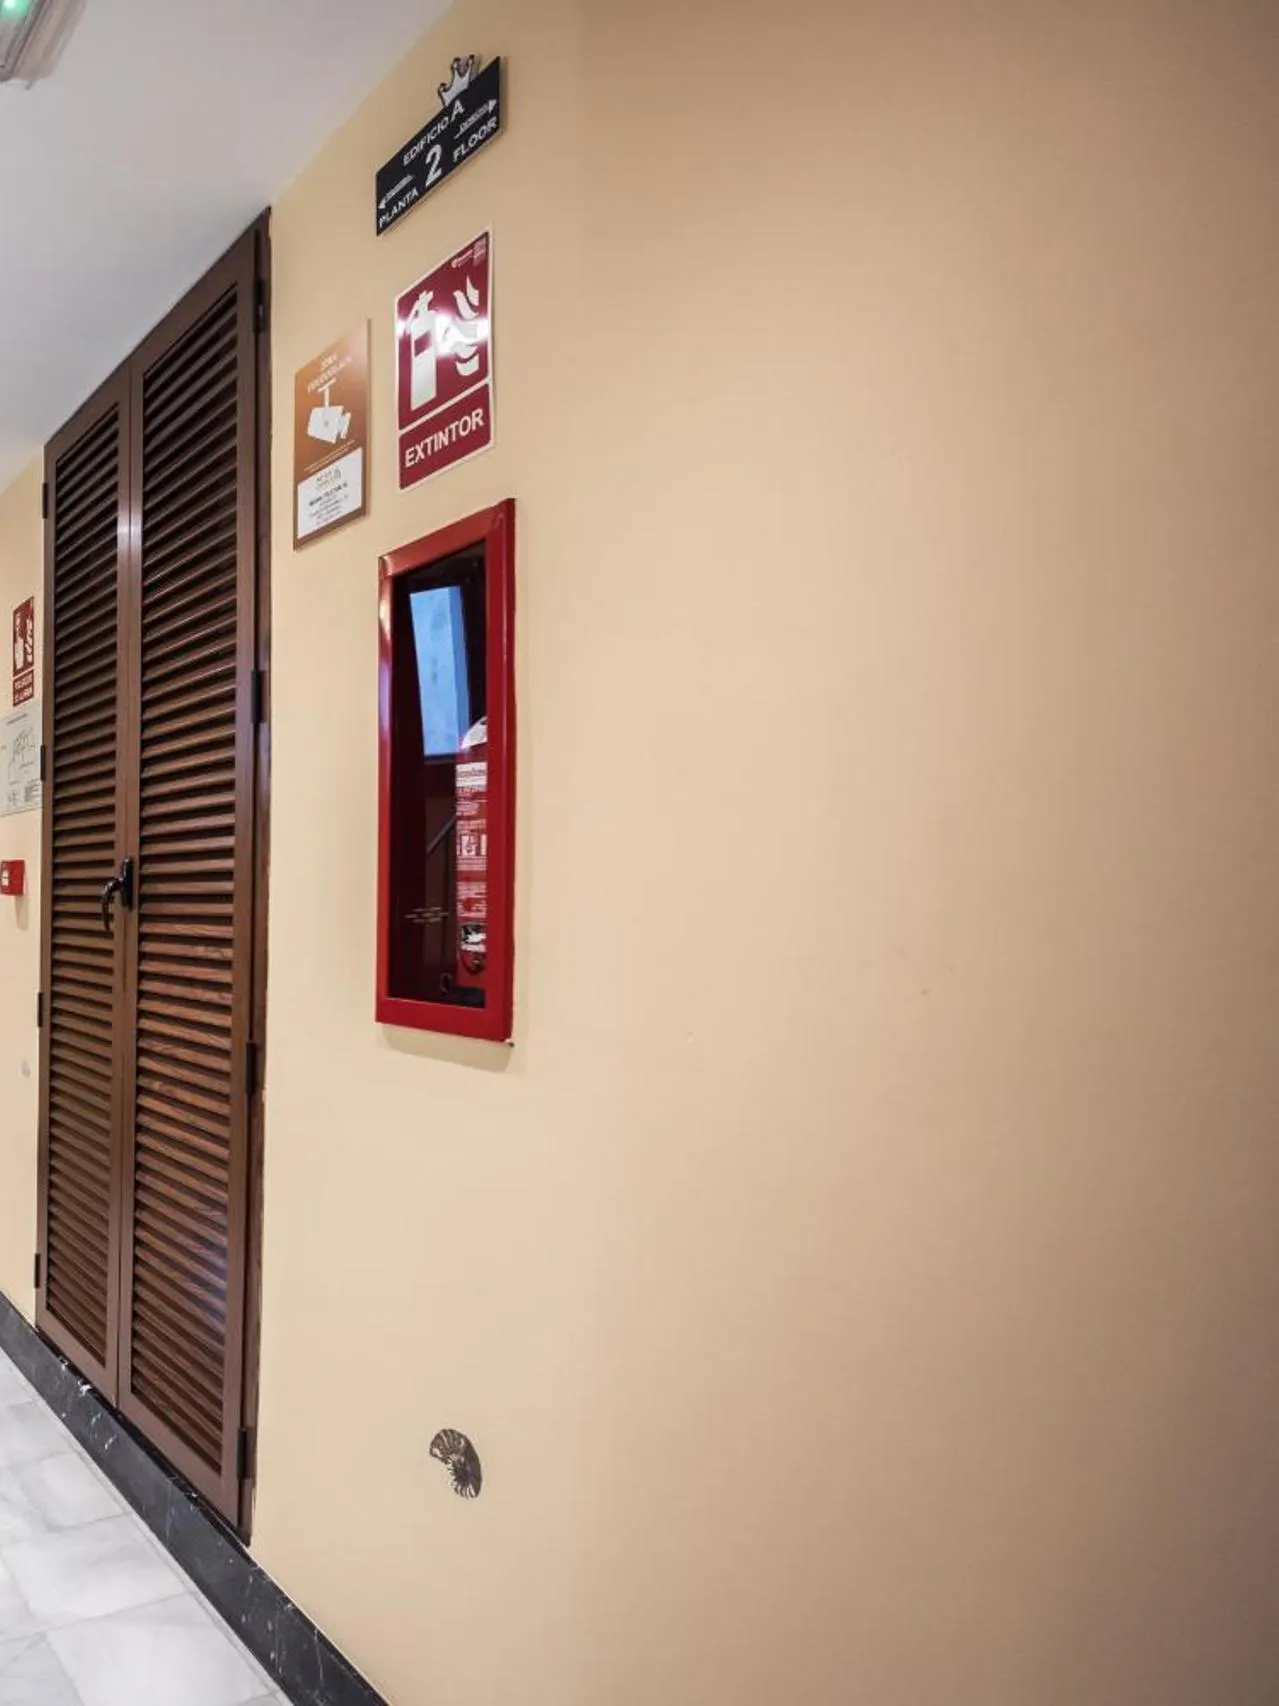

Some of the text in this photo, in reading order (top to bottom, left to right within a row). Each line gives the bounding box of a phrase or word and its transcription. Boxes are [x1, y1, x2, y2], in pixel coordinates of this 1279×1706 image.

[403, 101, 464, 166] EDIFICIO A
[379, 116, 498, 228] PLANTA 2 FLOOR
[404, 408, 484, 468] EXTINTOR
